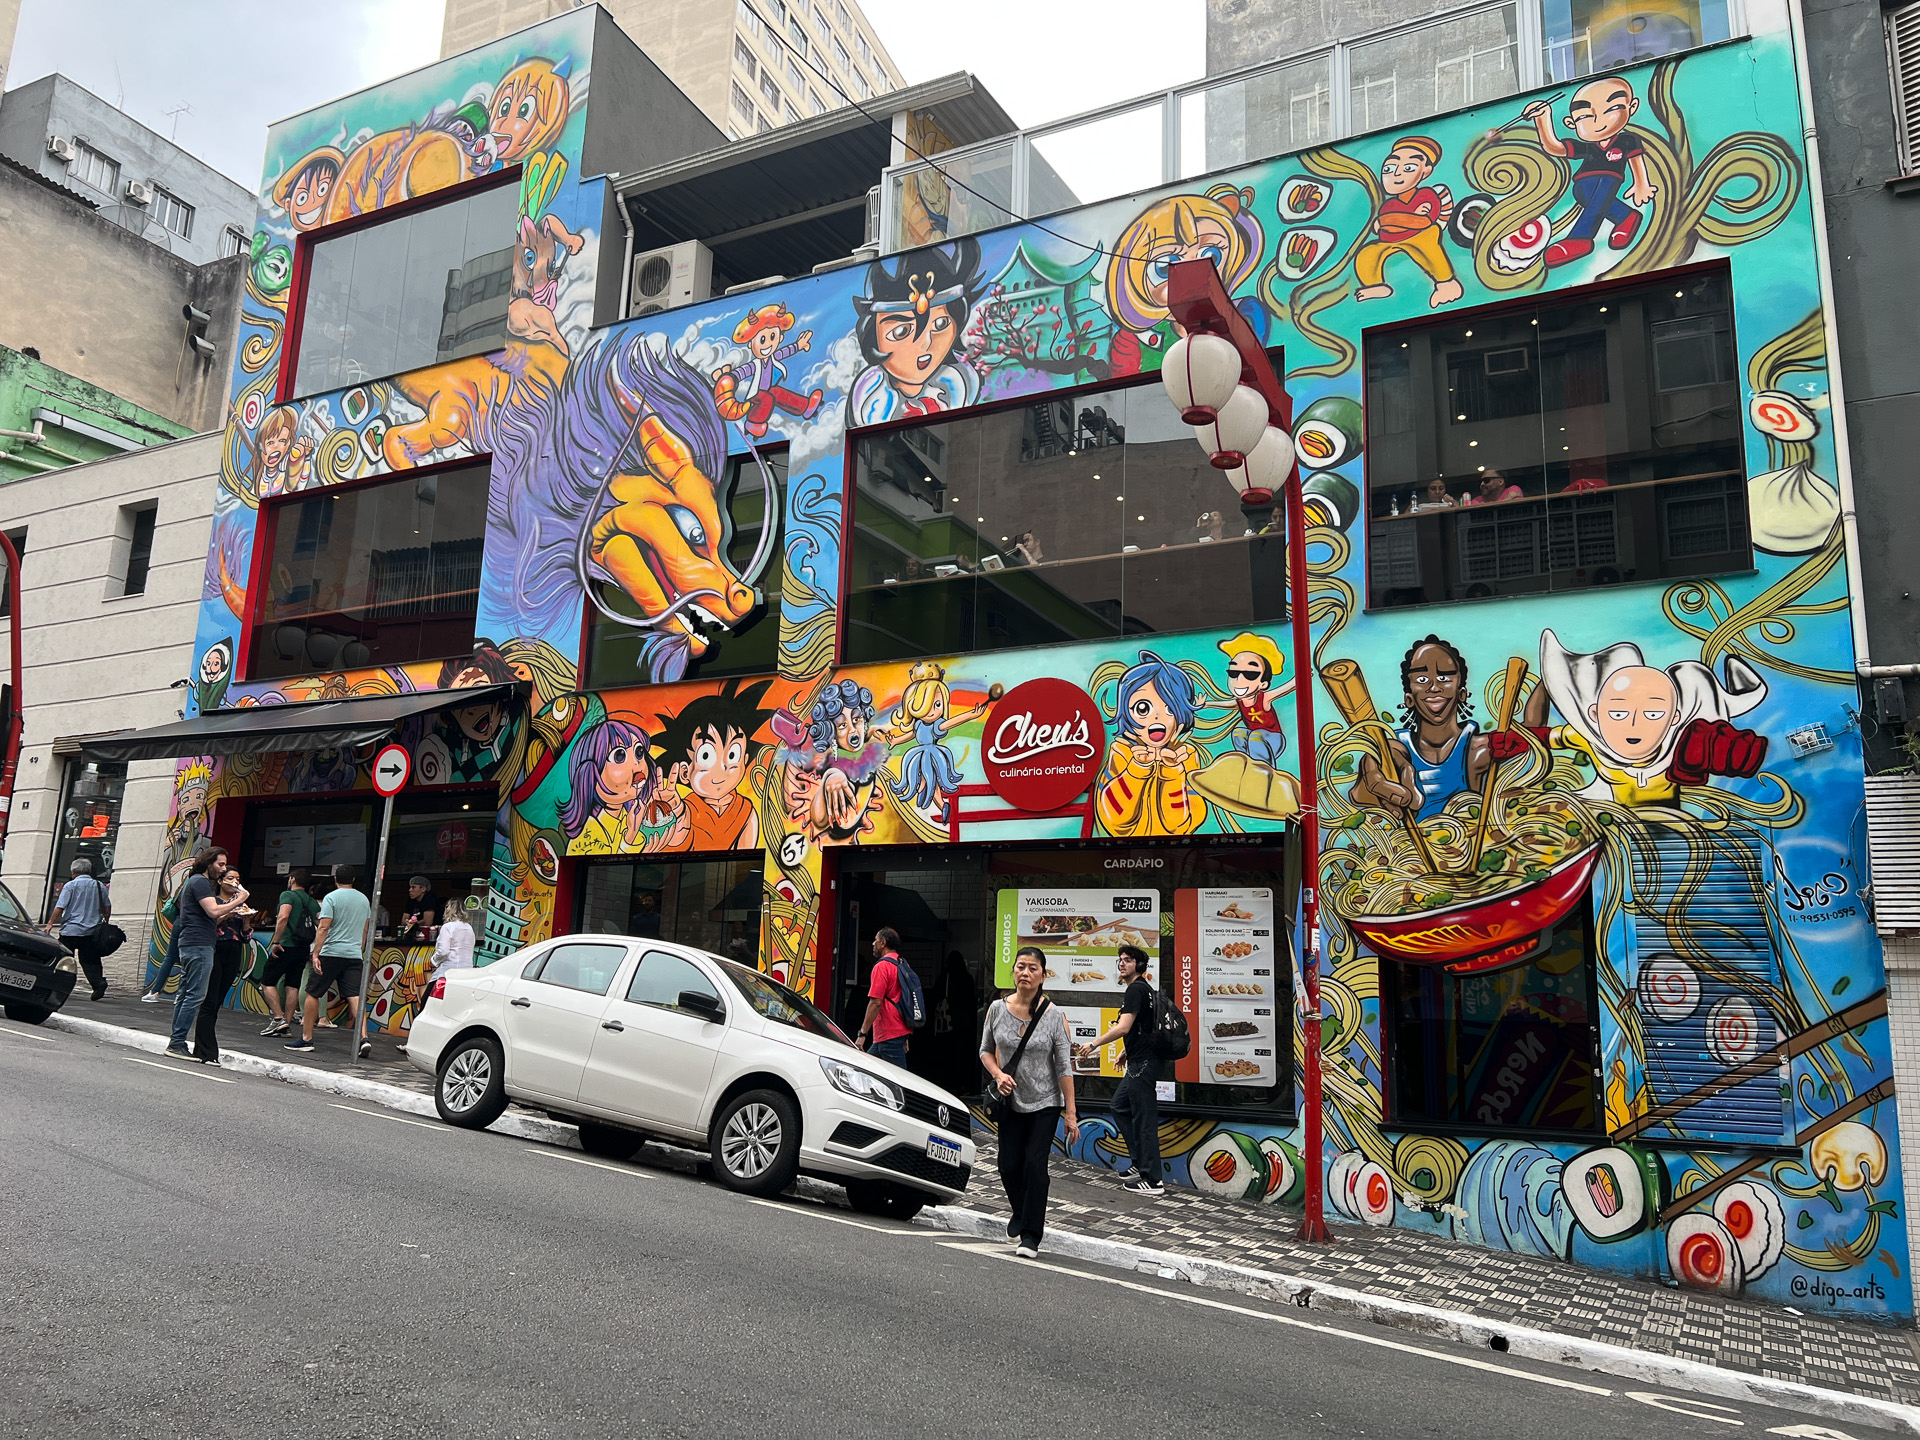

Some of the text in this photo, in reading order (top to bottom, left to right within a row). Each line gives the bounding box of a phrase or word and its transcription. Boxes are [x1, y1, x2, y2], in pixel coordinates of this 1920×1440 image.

[988, 710, 1095, 764] Chen's
[1000, 763, 1084, 777] culinária oriental
[783, 836, 805, 862] 57
[1104, 857, 1164, 869] CARDÁPIO
[1025, 897, 1068, 905] YAKISOBA
[1002, 913, 1012, 964] COMBOS
[1180, 955, 1193, 1013] PORÇÕES
[1791, 1273, 1886, 1306] @digo_arts
